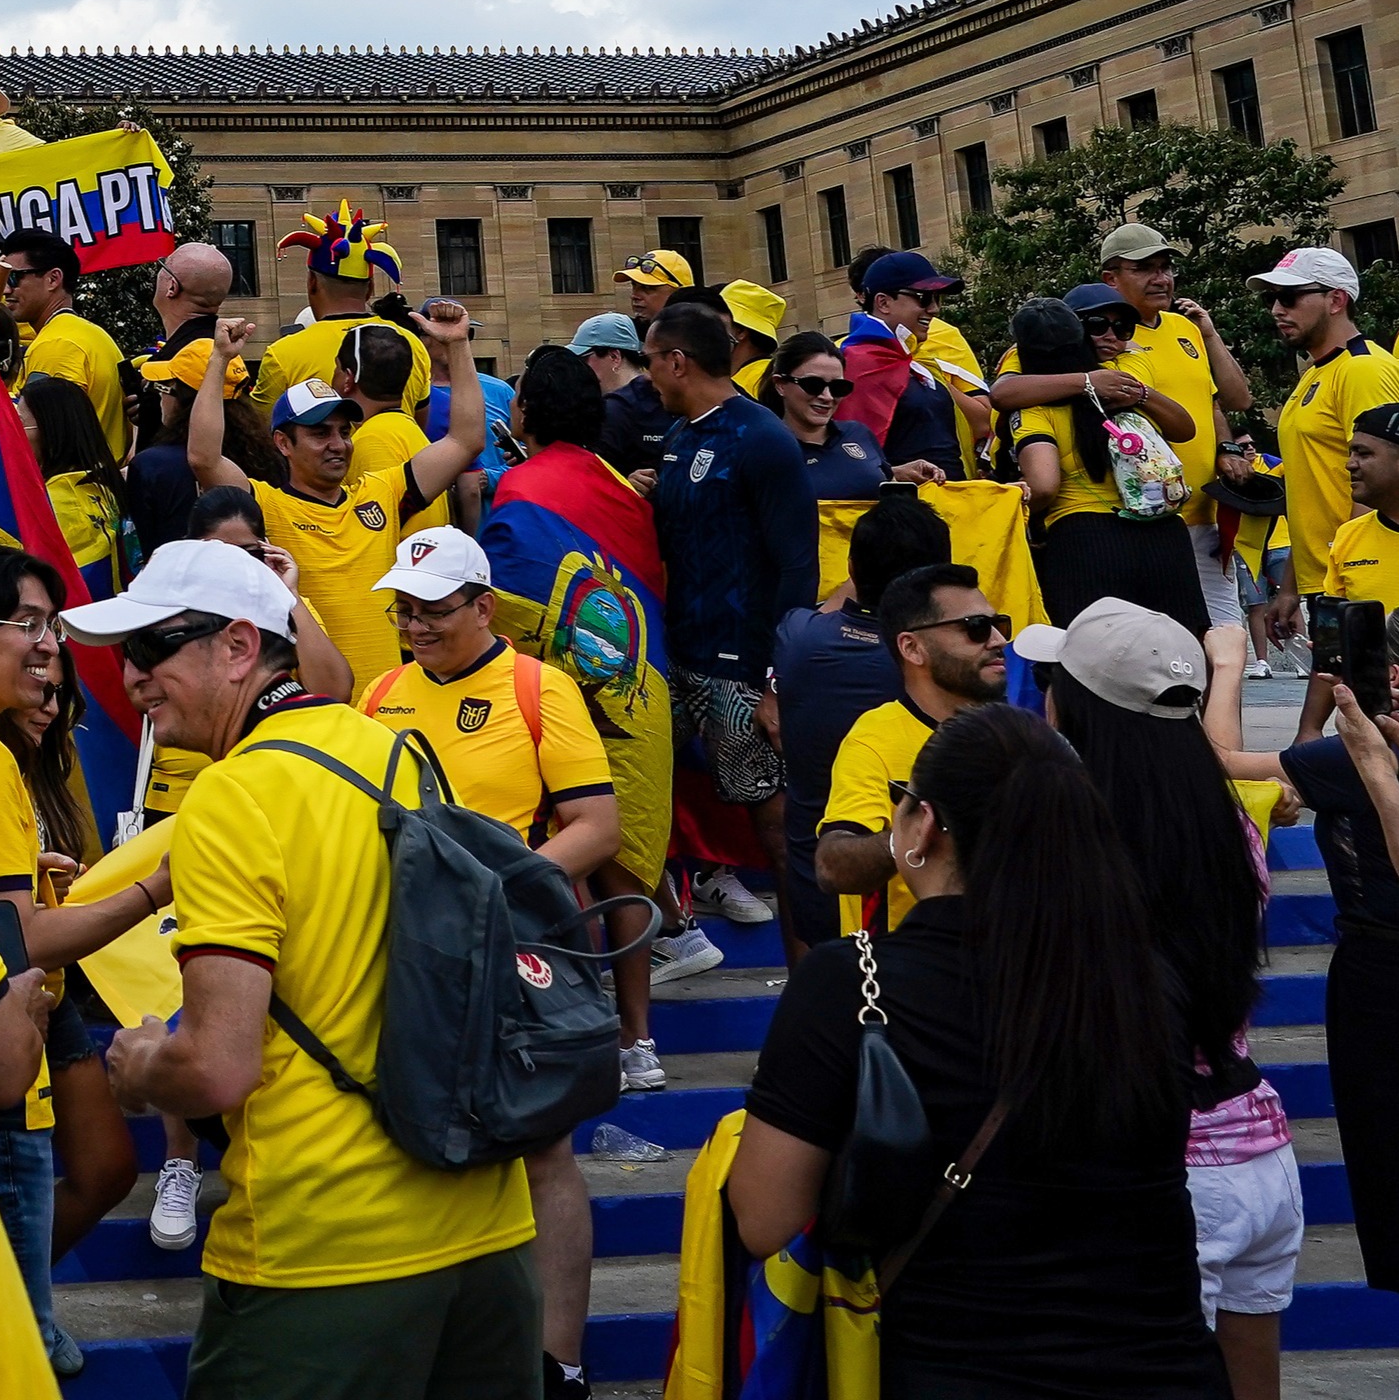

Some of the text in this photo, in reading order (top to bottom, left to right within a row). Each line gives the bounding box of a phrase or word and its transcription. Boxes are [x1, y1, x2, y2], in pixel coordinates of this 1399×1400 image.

[1343, 558, 1379, 568] marathon
[257, 680, 303, 711] Canon
[377, 705, 416, 715] arathon
